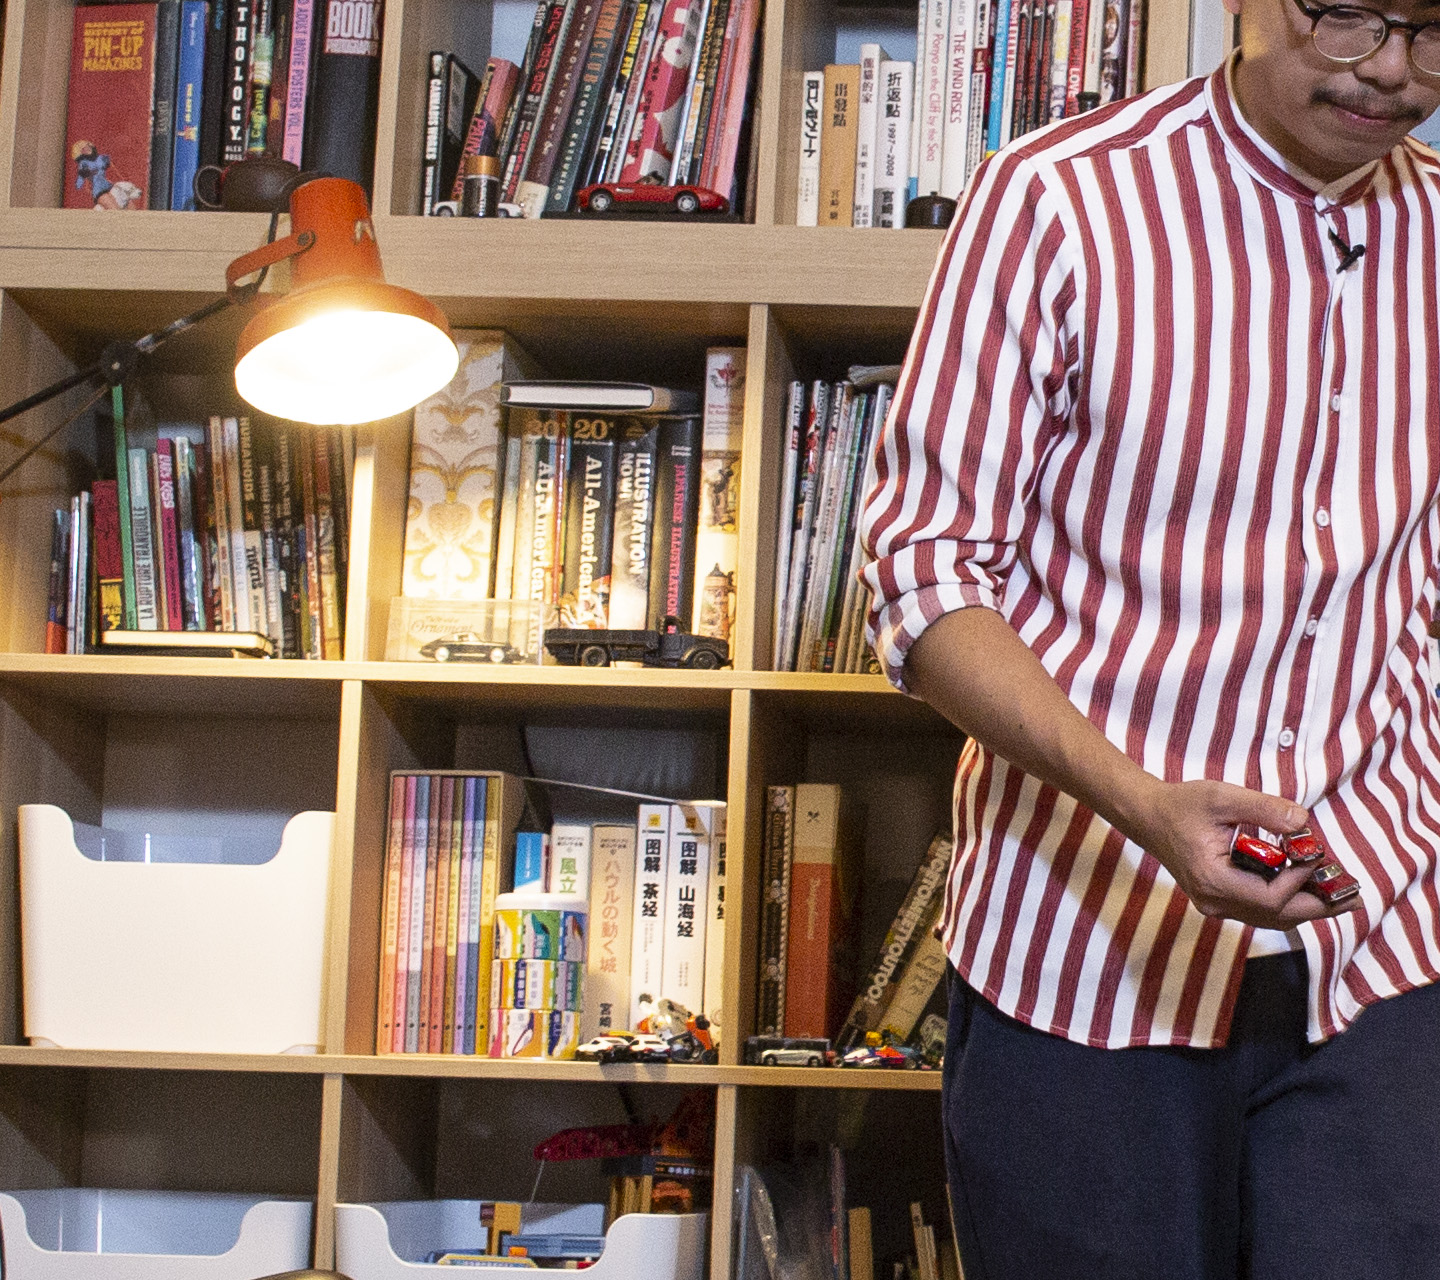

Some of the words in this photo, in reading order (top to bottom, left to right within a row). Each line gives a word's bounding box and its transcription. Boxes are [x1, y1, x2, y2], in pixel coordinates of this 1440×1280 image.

[296, 9, 310, 34] ADULT
[327, 1, 381, 39] BOOK
[936, 1, 944, 15] ART
[84, 36, 143, 56] PIN-UP
[294, 38, 308, 65] MOVIE
[932, 32, 944, 66] Ponyo
[956, 30, 968, 52] THE
[82, 57, 143, 71] MAGAZINES
[953, 57, 965, 87] WIND
[291, 69, 306, 108] POSTERS
[885, 71, 902, 118] 折返點
[950, 91, 963, 123] RISES
[927, 143, 939, 162] Sea
[620, 453, 634, 500] NOW!
[672, 464, 686, 523] JAPANESE
[627, 452, 651, 575] ILLUSTRATION
[133, 506, 150, 560] TRANQUILLE
[136, 564, 153, 605] RUPTURE
[666, 526, 684, 617] ILLUSTRATION
[644, 838, 661, 873] 图解
[679, 840, 698, 876] 图解
[599, 859, 619, 973] ハウルの動く城
[641, 883, 658, 917] 茶经
[676, 885, 696, 938] 山海经
